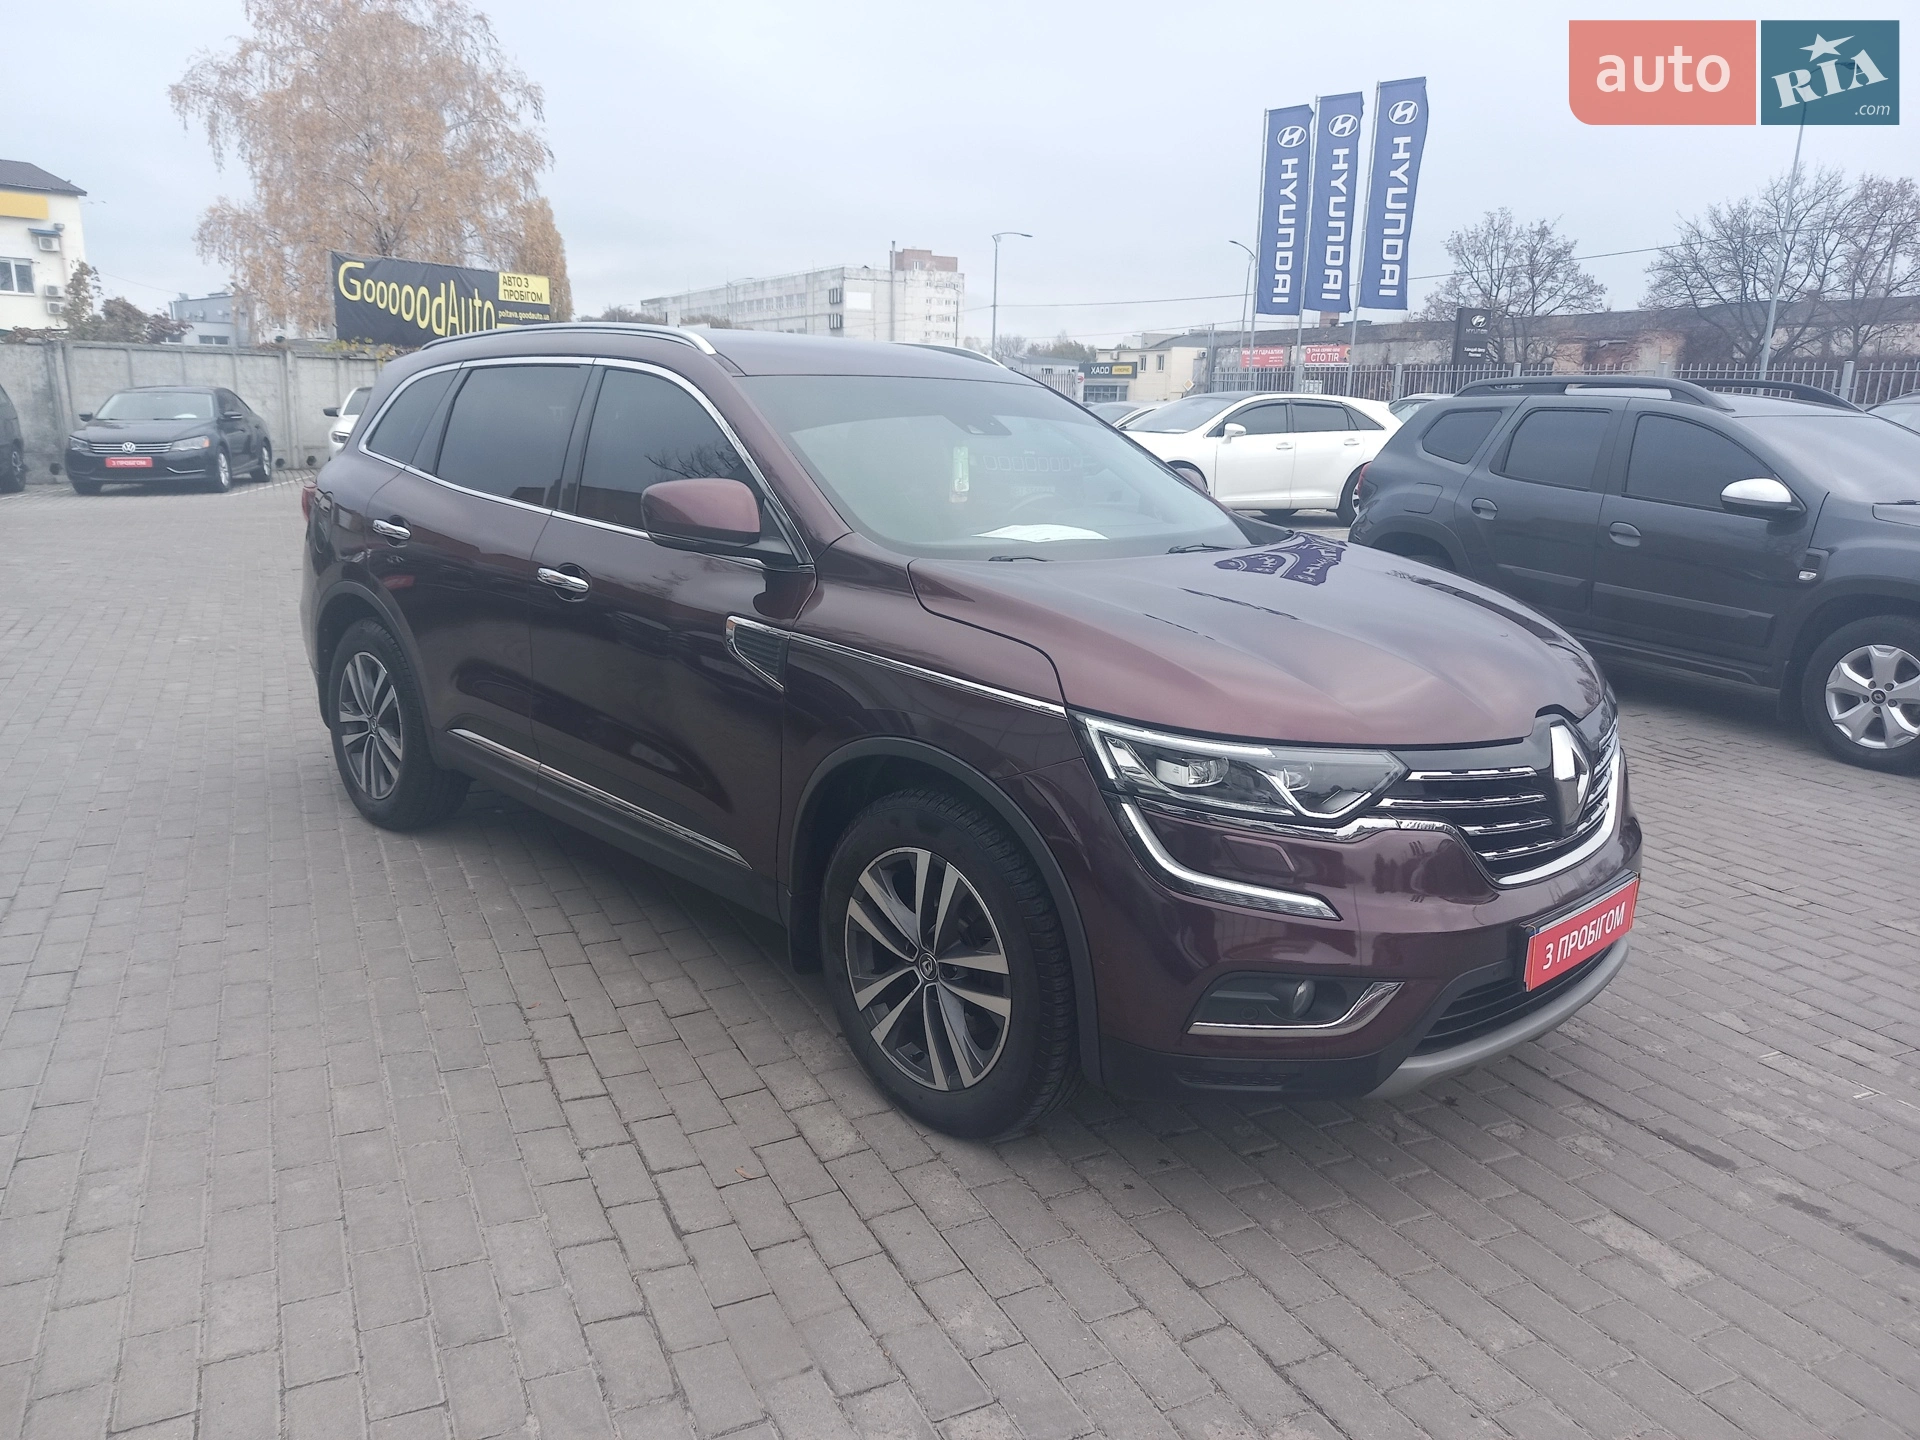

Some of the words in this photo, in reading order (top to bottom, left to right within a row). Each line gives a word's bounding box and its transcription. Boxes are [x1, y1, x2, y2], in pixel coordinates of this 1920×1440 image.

[1272, 157, 1299, 304] HYUNDAI
[1321, 147, 1350, 300] HYUNDAI
[1378, 135, 1411, 297] HYUNDAI
[502, 275, 522, 287] АВТО
[503, 289, 544, 303] ПРОБІГОМ
[1542, 942, 1554, 970] З
[1556, 901, 1626, 963] ПРОБІГОМ
